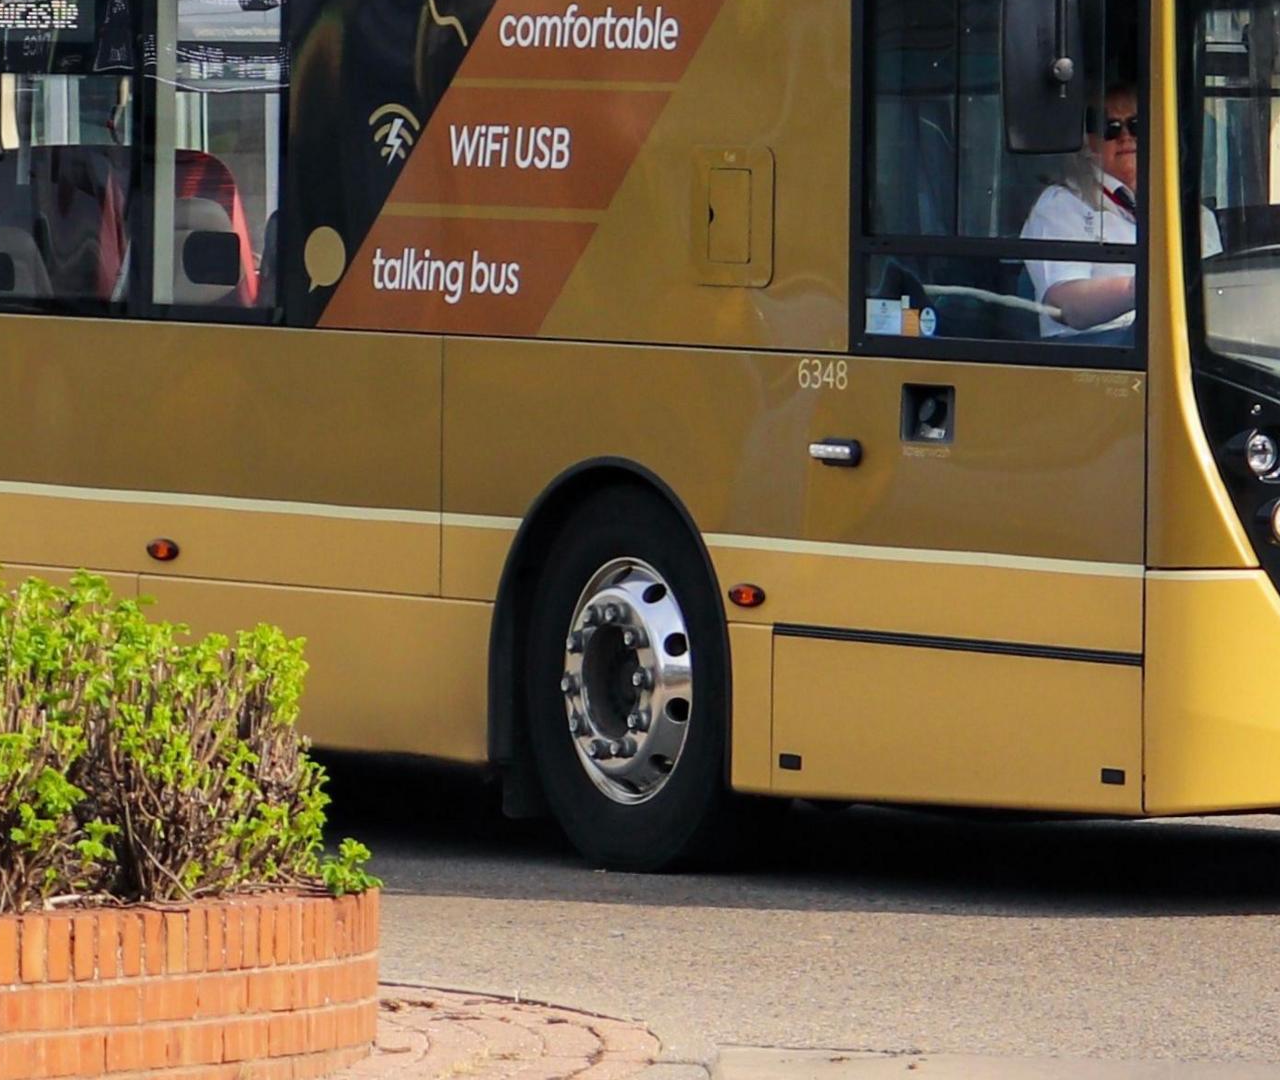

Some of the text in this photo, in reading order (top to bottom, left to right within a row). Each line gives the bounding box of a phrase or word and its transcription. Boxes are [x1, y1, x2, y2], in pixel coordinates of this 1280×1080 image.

[498, 5, 678, 51] comfortable
[449, 123, 571, 170] WiFi USB
[372, 248, 520, 304] talking bus
[798, 358, 848, 390] 6348
